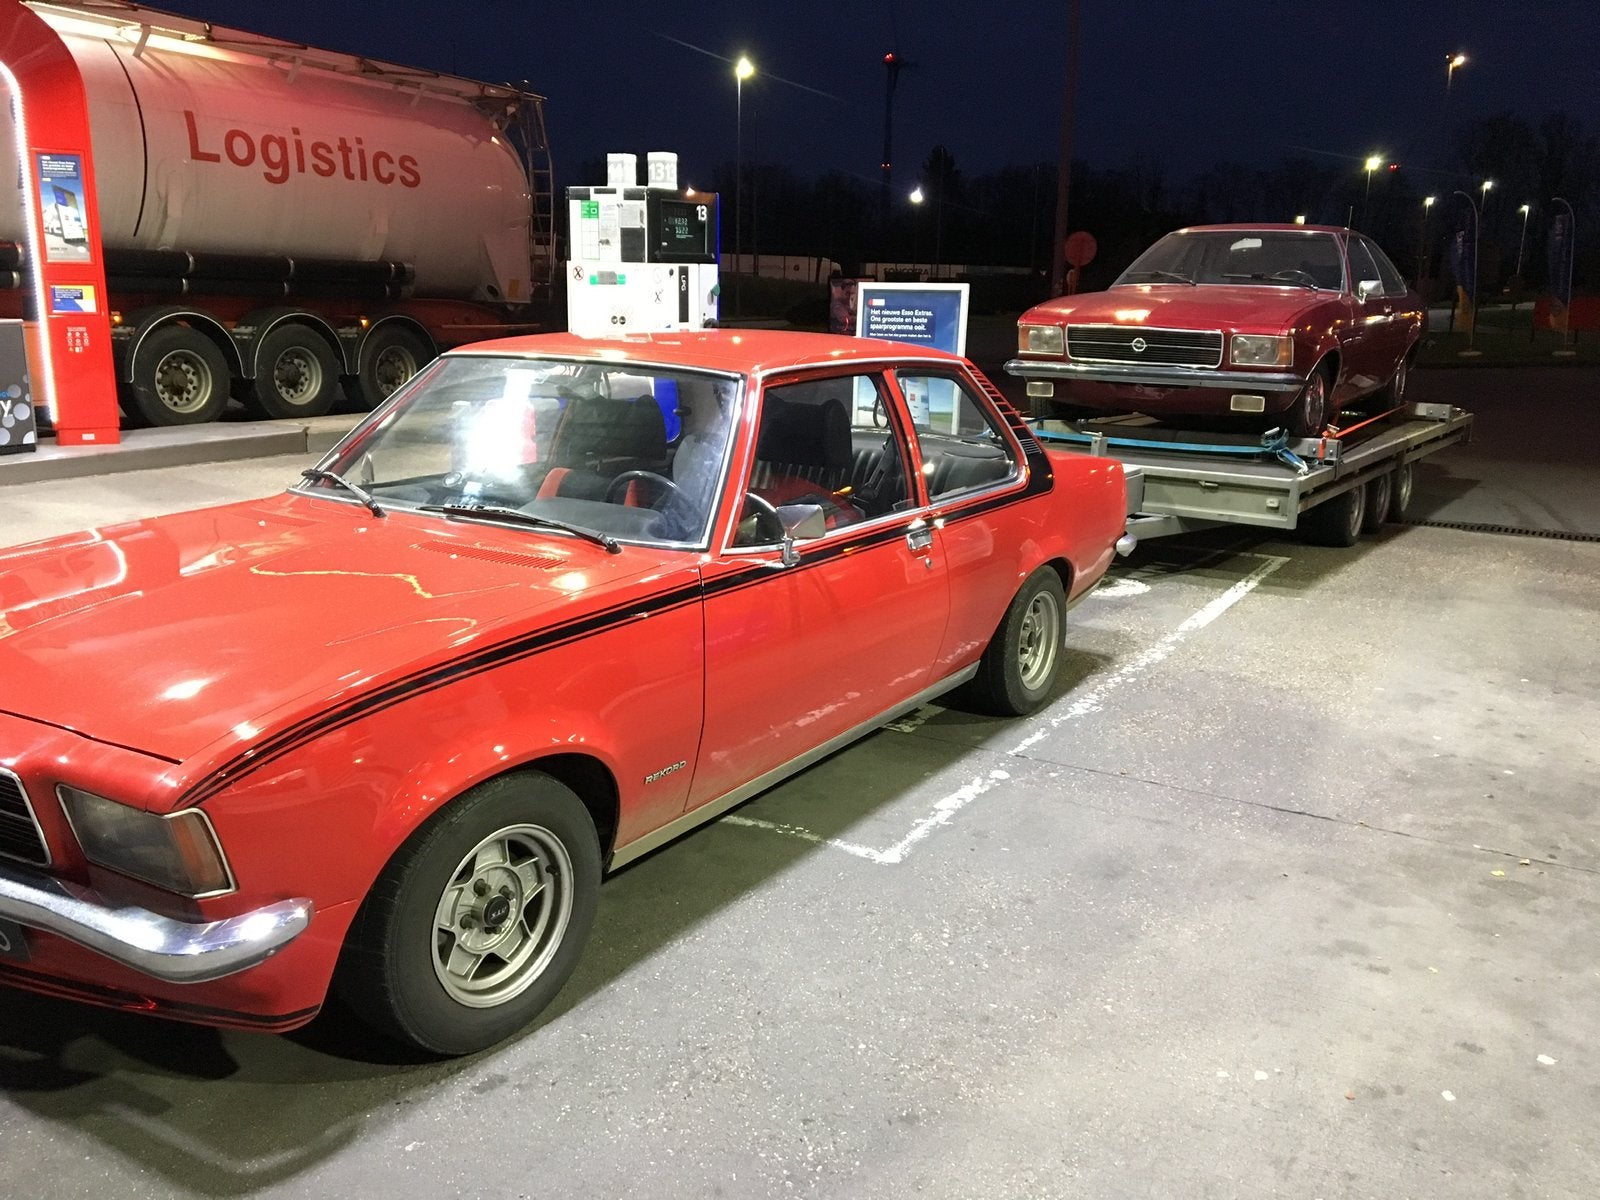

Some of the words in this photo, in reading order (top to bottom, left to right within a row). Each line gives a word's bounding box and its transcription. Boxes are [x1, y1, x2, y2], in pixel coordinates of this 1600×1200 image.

[184, 110, 421, 188] Logistics
[696, 204, 708, 221] 13
[645, 760, 687, 784] REKORD
